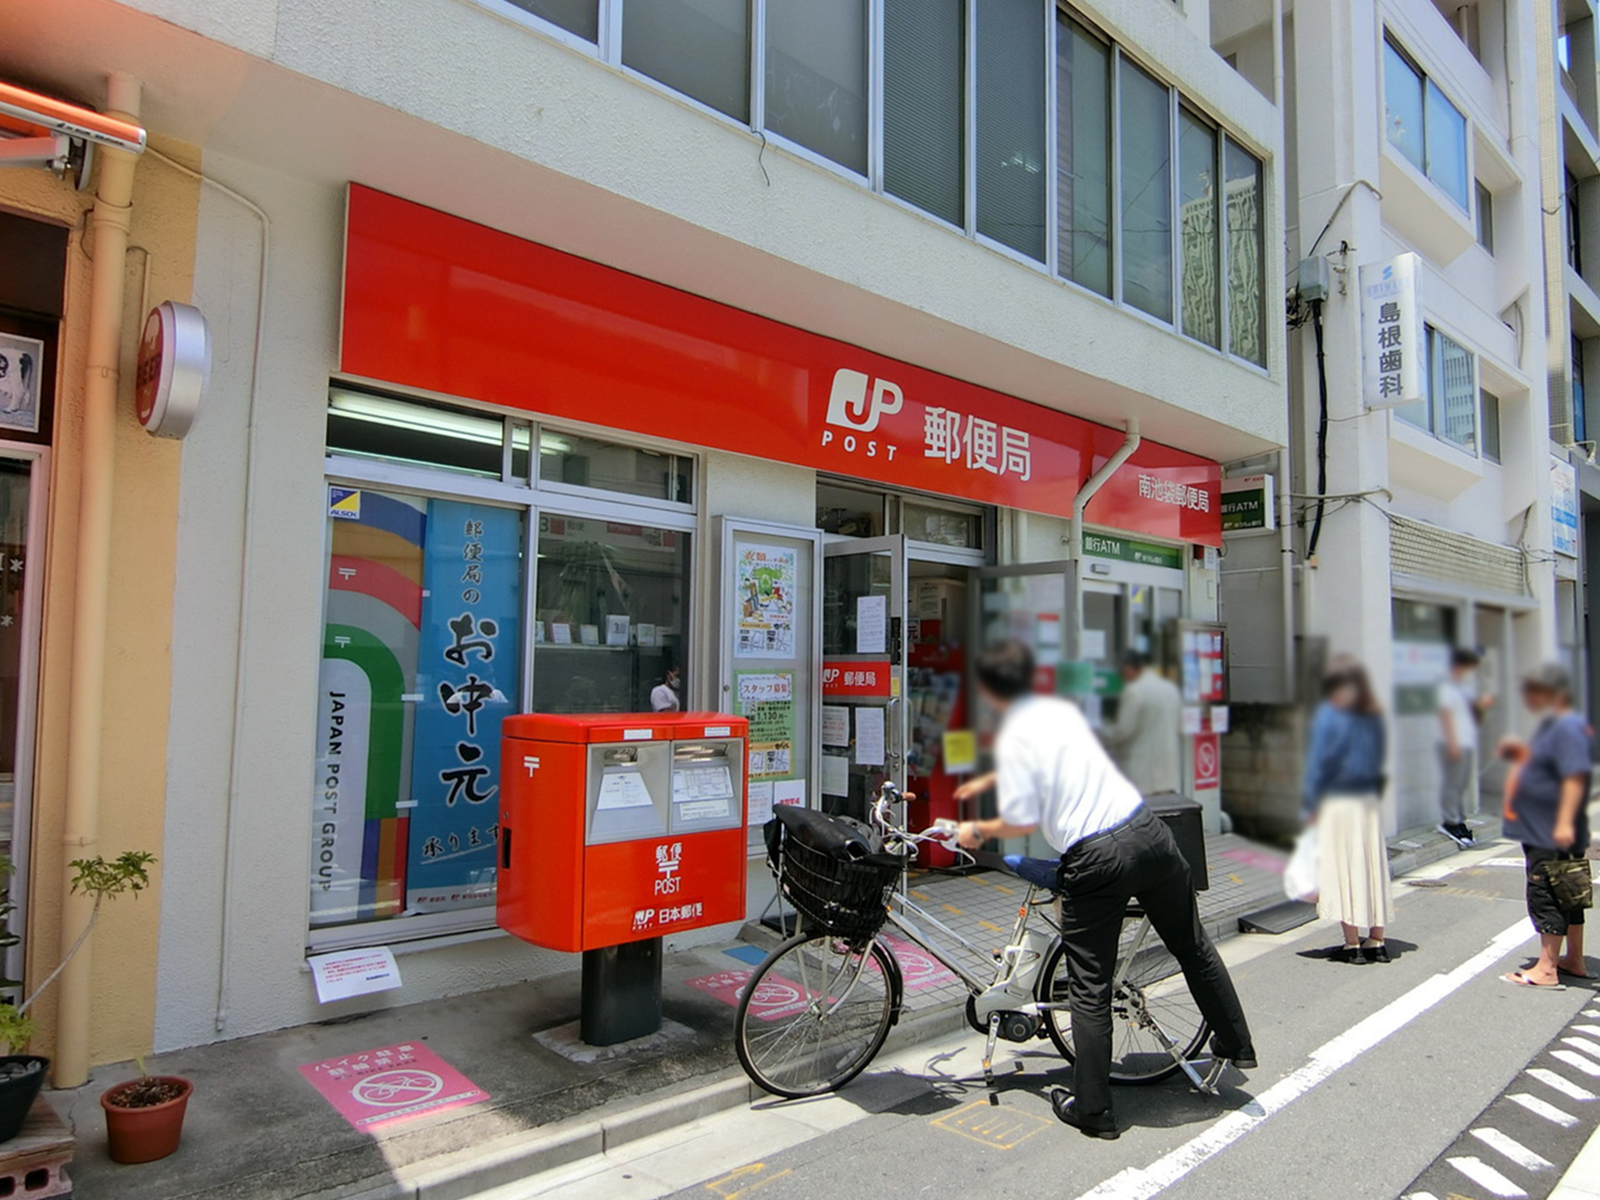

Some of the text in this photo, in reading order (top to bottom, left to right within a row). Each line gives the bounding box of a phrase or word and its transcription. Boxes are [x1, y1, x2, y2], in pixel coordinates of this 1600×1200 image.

[1378, 302, 1403, 398] 島根歯科
[826, 368, 904, 432] JP
[821, 430, 897, 461] POST
[924, 405, 1031, 482] 郵便局
[1138, 474, 1210, 513] 南池袋郵便局
[461, 518, 484, 604] 郵便局の
[1085, 535, 1121, 556] 銀行ATM
[844, 671, 876, 687] 郵便局
[438, 611, 499, 808] お中元
[317, 691, 346, 892] JAPAN POST GROUP
[655, 842, 682, 863] 郵便
[654, 876, 681, 896] POST
[659, 902, 703, 924] 日本郵便
